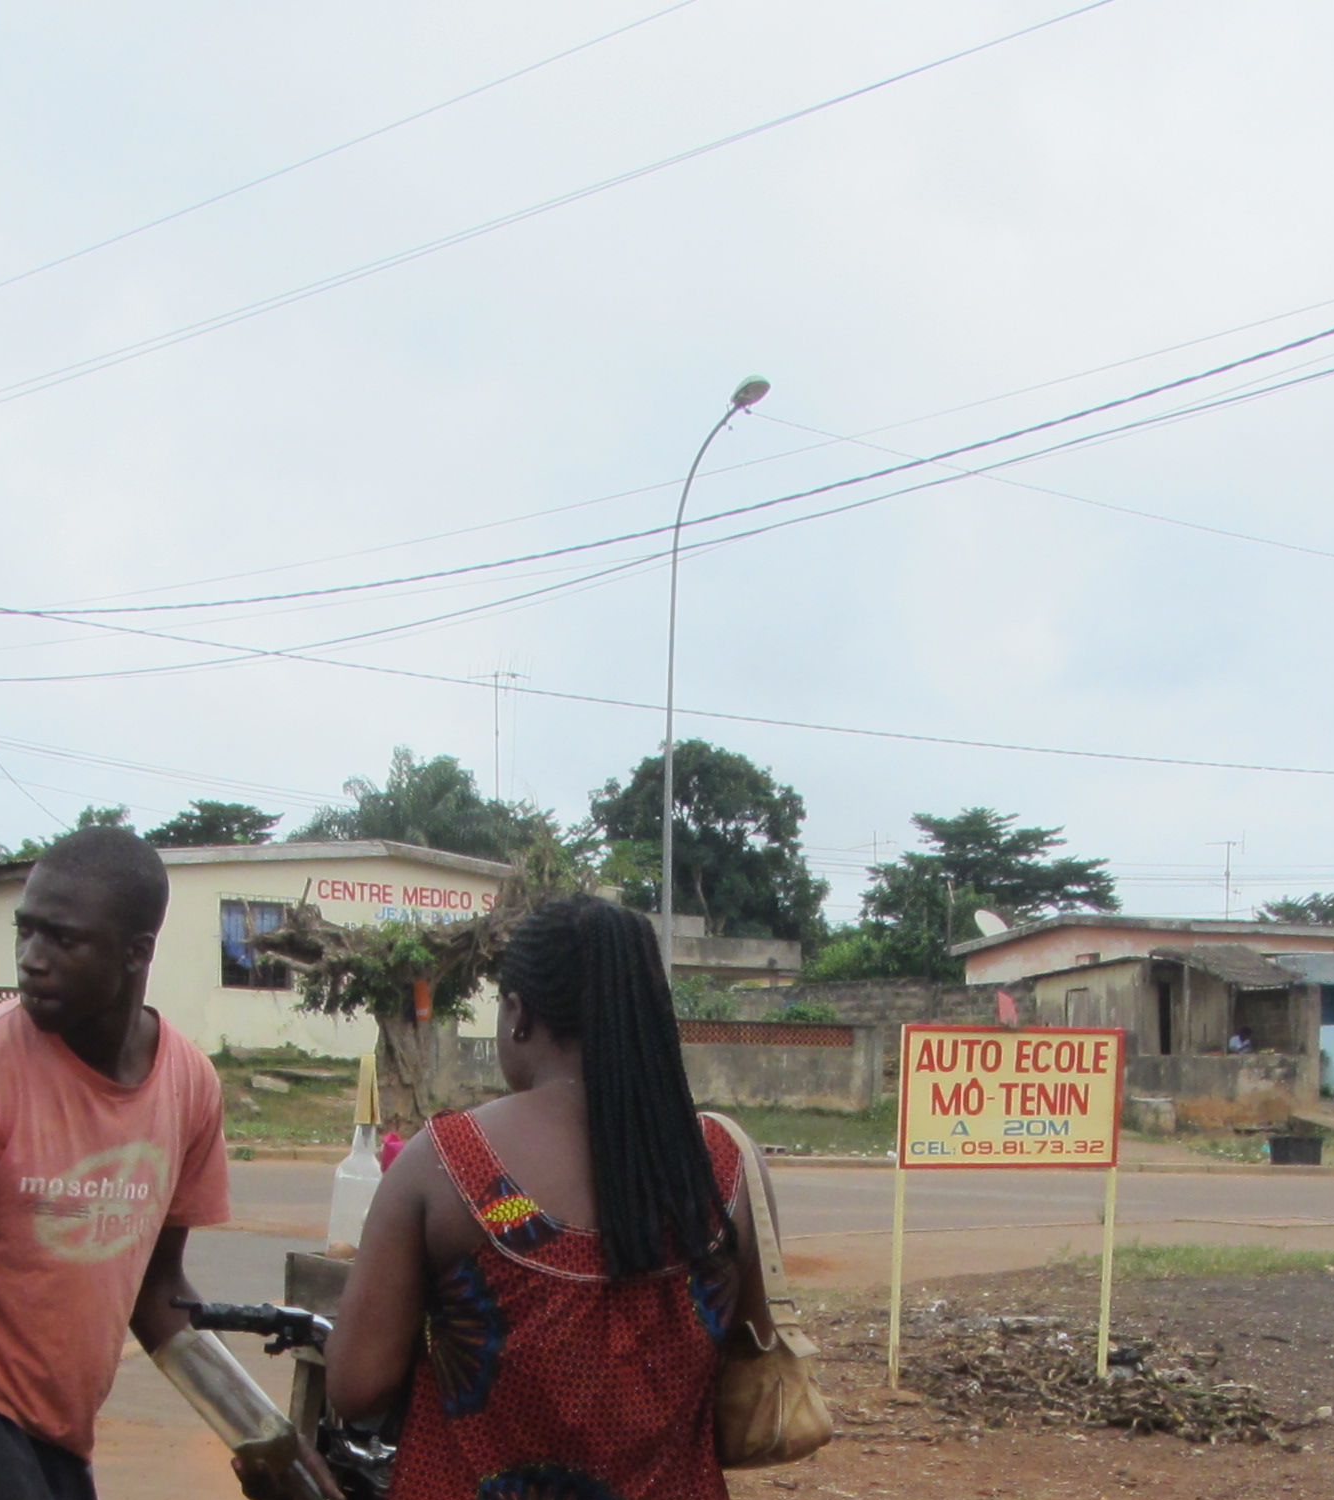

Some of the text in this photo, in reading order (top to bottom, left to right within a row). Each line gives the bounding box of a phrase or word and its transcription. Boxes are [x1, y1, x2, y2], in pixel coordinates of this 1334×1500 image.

[318, 879, 393, 904] CENTRE
[402, 886, 472, 910] MEDICO
[915, 1039, 1109, 1074] AUTO ECOLE
[951, 1120, 970, 1136] A
[911, 1141, 956, 1156] CEL:
[19, 1176, 149, 1200] moschino
